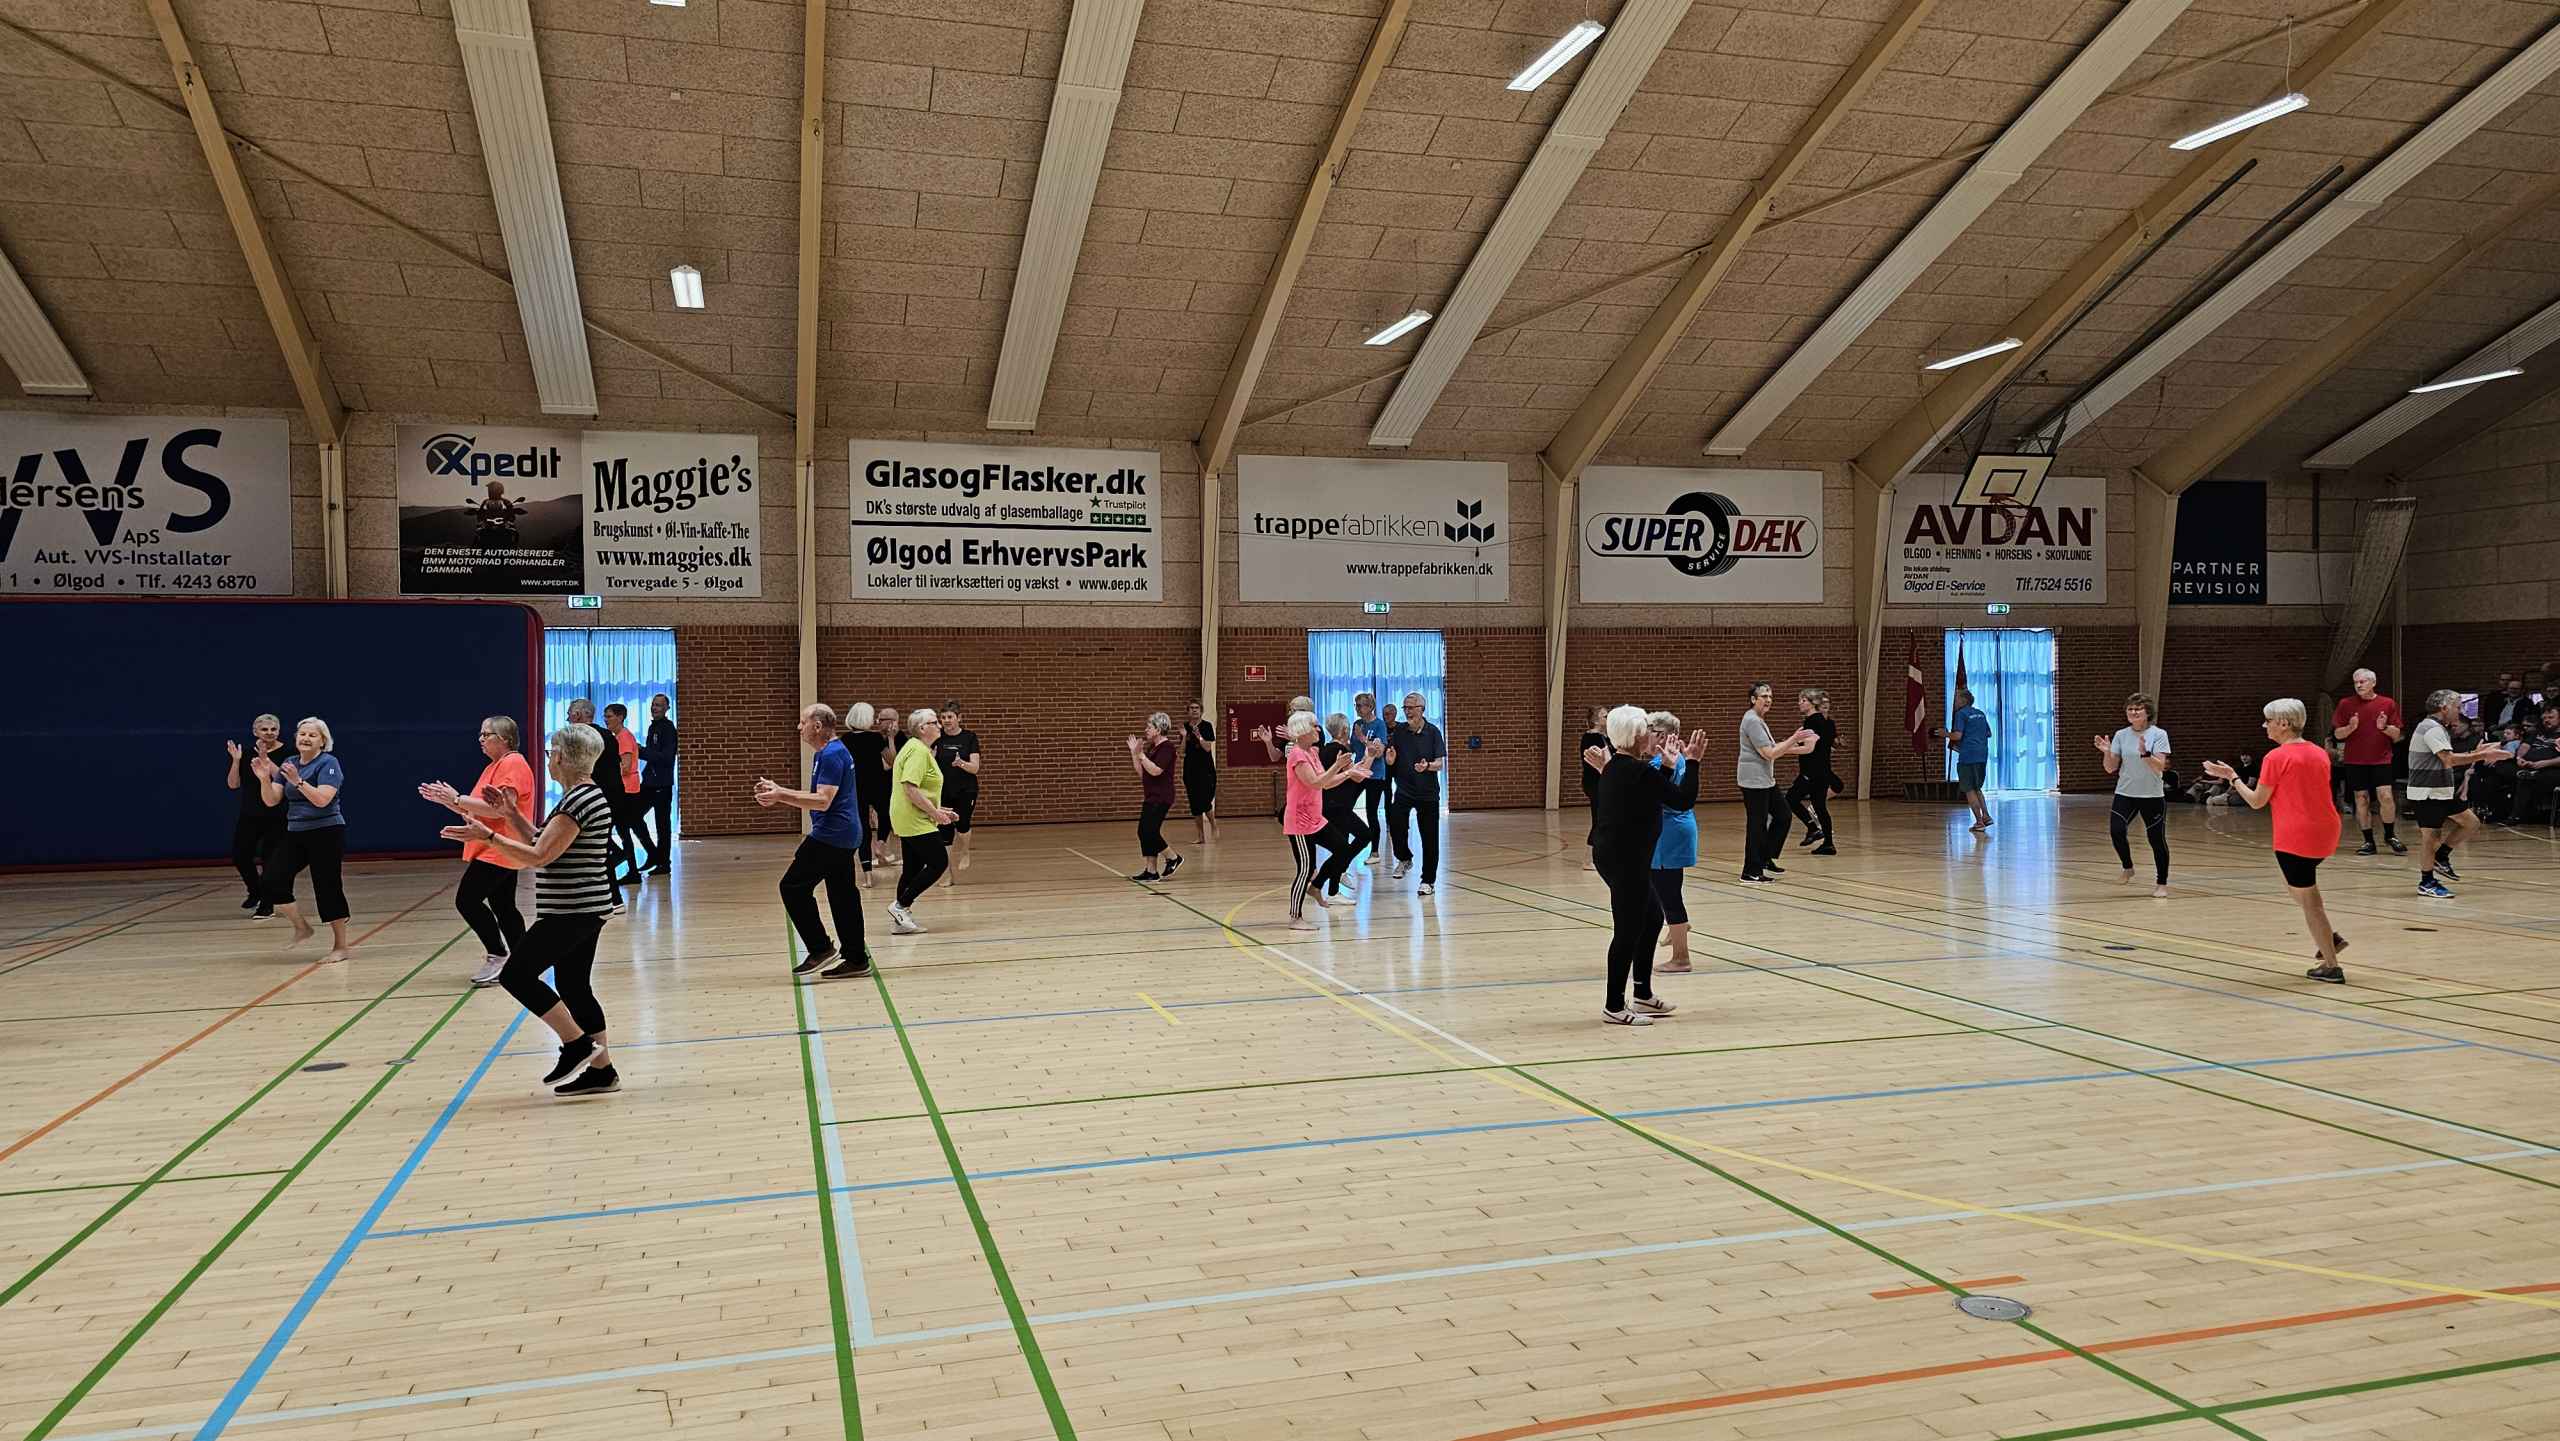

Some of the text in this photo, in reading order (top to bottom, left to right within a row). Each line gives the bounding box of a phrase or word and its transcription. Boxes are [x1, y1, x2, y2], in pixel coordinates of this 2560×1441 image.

[431, 440, 561, 485] Xpedit
[593, 455, 753, 514] Maggie's
[865, 460, 1146, 497] GlasogFlasker.dk
[866, 499, 1083, 521] DK's største udvalg af glasemballage
[1104, 499, 1146, 510] Trustpilot
[593, 521, 750, 541] Brugskunst Øl-Vin-Kaffe-The
[1254, 512, 1440, 539] trappefabrikken
[1904, 505, 2092, 546] AVDAN
[123, 529, 160, 546] ApS
[1602, 518, 1806, 552] SUPER DÆK
[34, 549, 231, 566] Aut. VVS-Installatør
[484, 549, 554, 557] AUTORISEREDE
[596, 545, 752, 572] www.maggies.dk
[867, 536, 1147, 570] Ølgod ErhvervsPark
[1688, 532, 1727, 570] SERVICE
[1904, 548, 2092, 560] ØLGOD HERNING HORSENS SKOVLUNDE
[1346, 562, 1493, 576] www.trappefabrikken.dk
[2172, 562, 2260, 576] PARTNER
[53, 573, 104, 590] Ølgod
[136, 574, 165, 588] Tlf.
[172, 575, 211, 588] 4243
[217, 576, 256, 589] 6870
[606, 575, 677, 590] Torvegade
[682, 577, 690, 589] 5
[704, 576, 743, 591] Ølgod
[867, 574, 1147, 592] Lokaler til iværksætteri og vækst www.øep.dk
[1904, 580, 1934, 592] Ølgod
[2064, 578, 2092, 591] 5516
[2172, 582, 2260, 594] REVISION
